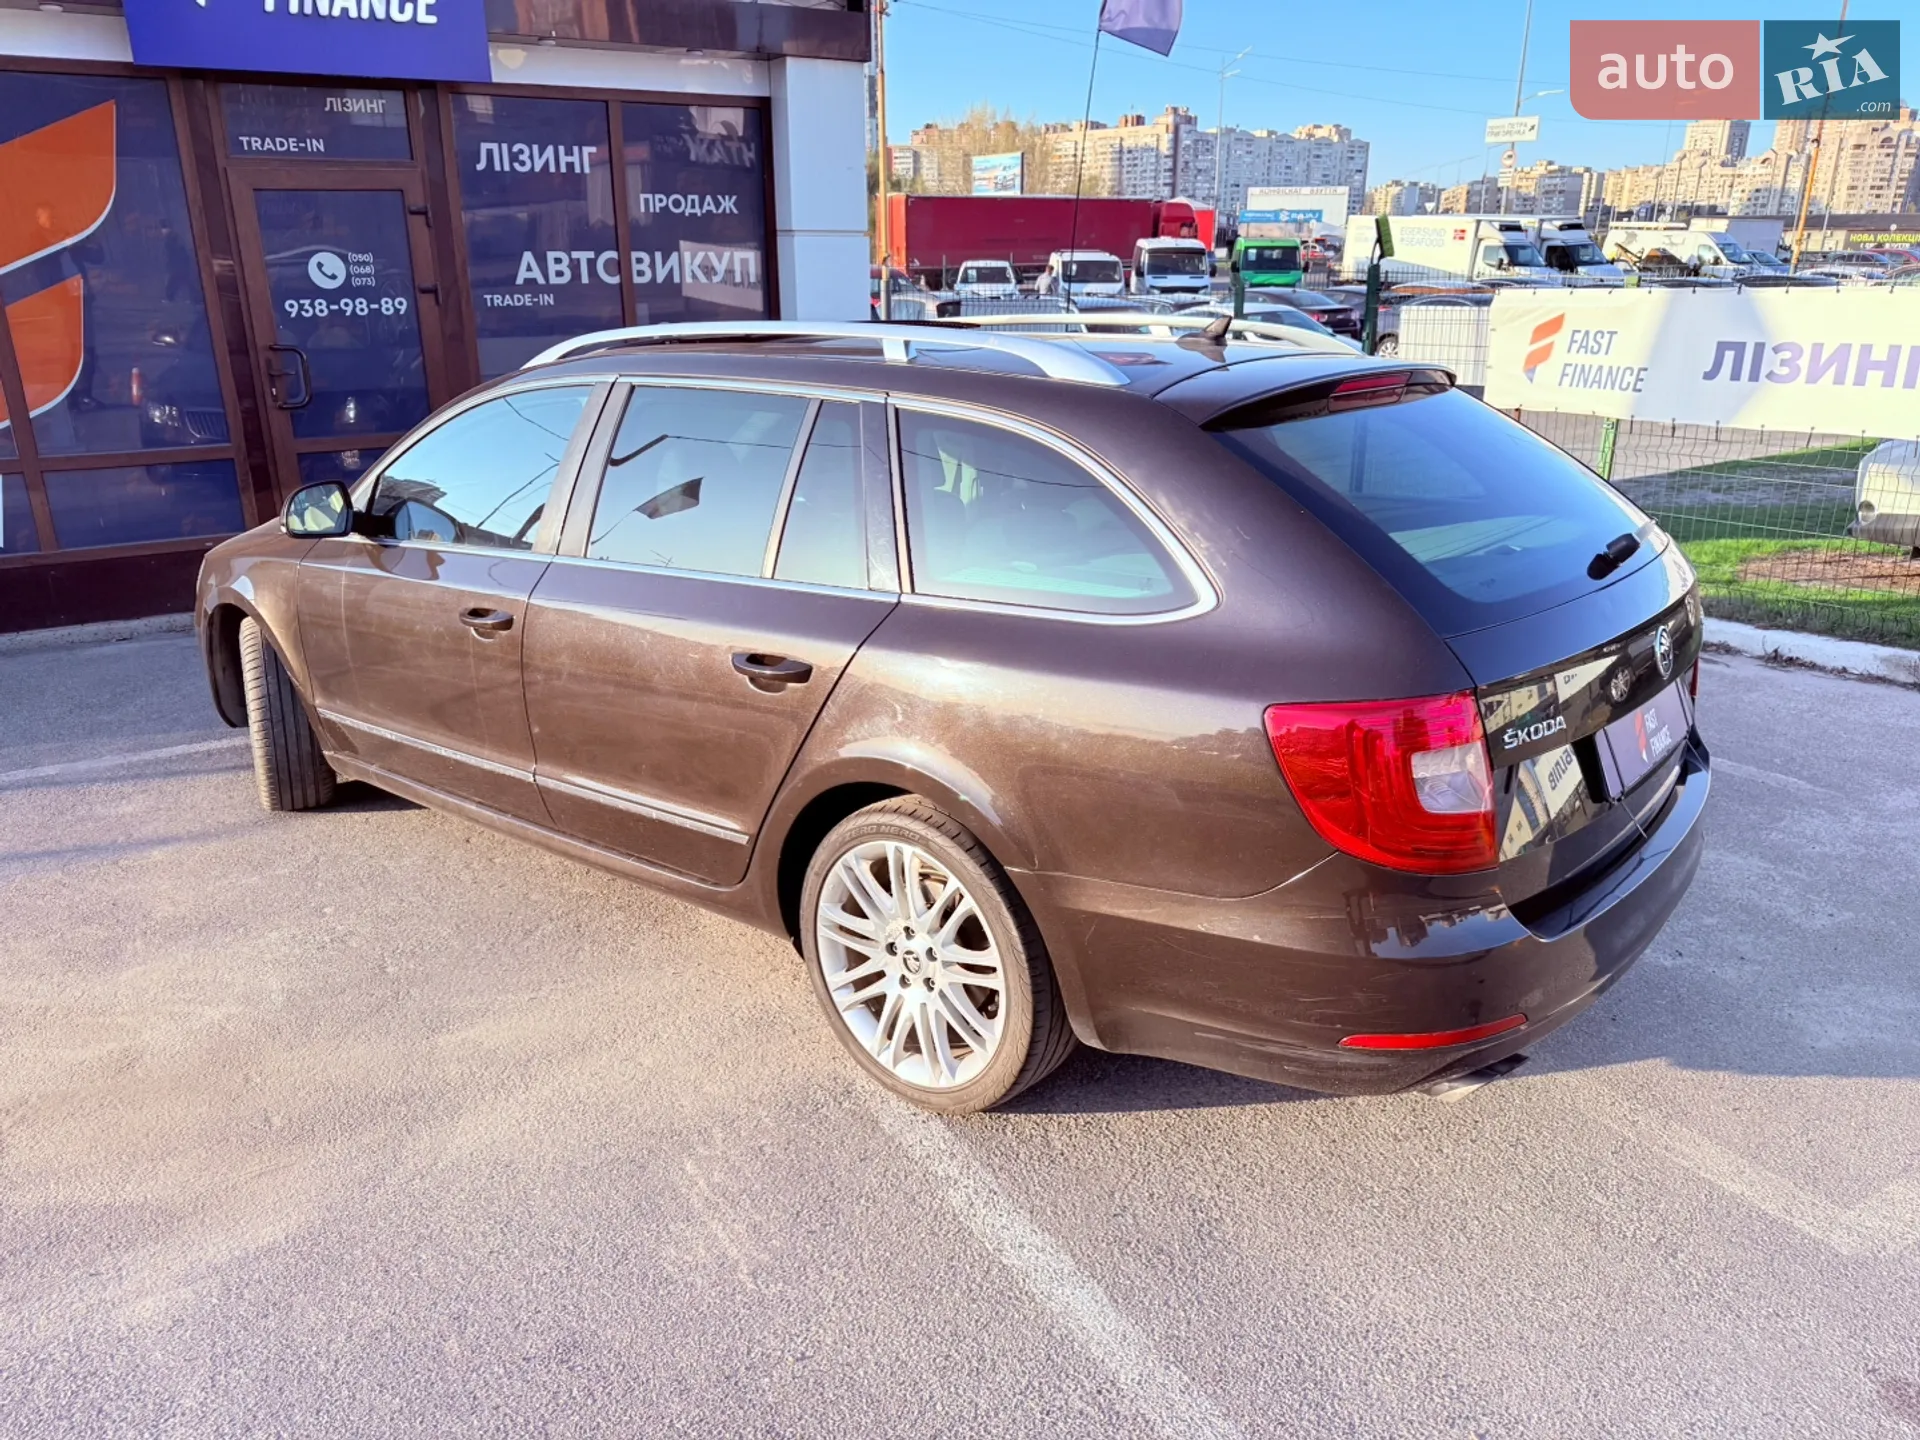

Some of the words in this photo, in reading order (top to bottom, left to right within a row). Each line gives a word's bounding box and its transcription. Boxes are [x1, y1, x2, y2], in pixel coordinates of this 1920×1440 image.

[324, 97, 386, 113] ЛІЗИНГ
[239, 136, 325, 153] TRADE-IN
[476, 142, 597, 174] ЛІЗИНГ
[640, 193, 739, 217] ПРОДАЖ
[1849, 233, 1875, 242] НОВА
[348, 252, 374, 263] (050)
[350, 264, 375, 275] (068)
[515, 250, 757, 285] АВТОВИКУП
[351, 276, 376, 287] (073)
[284, 297, 408, 319] 938-98-89
[483, 293, 555, 307] TRADE-IN
[1567, 329, 1618, 356] FAST
[1558, 362, 1649, 393] FINANCE
[1502, 716, 1567, 749] ŠKODA
